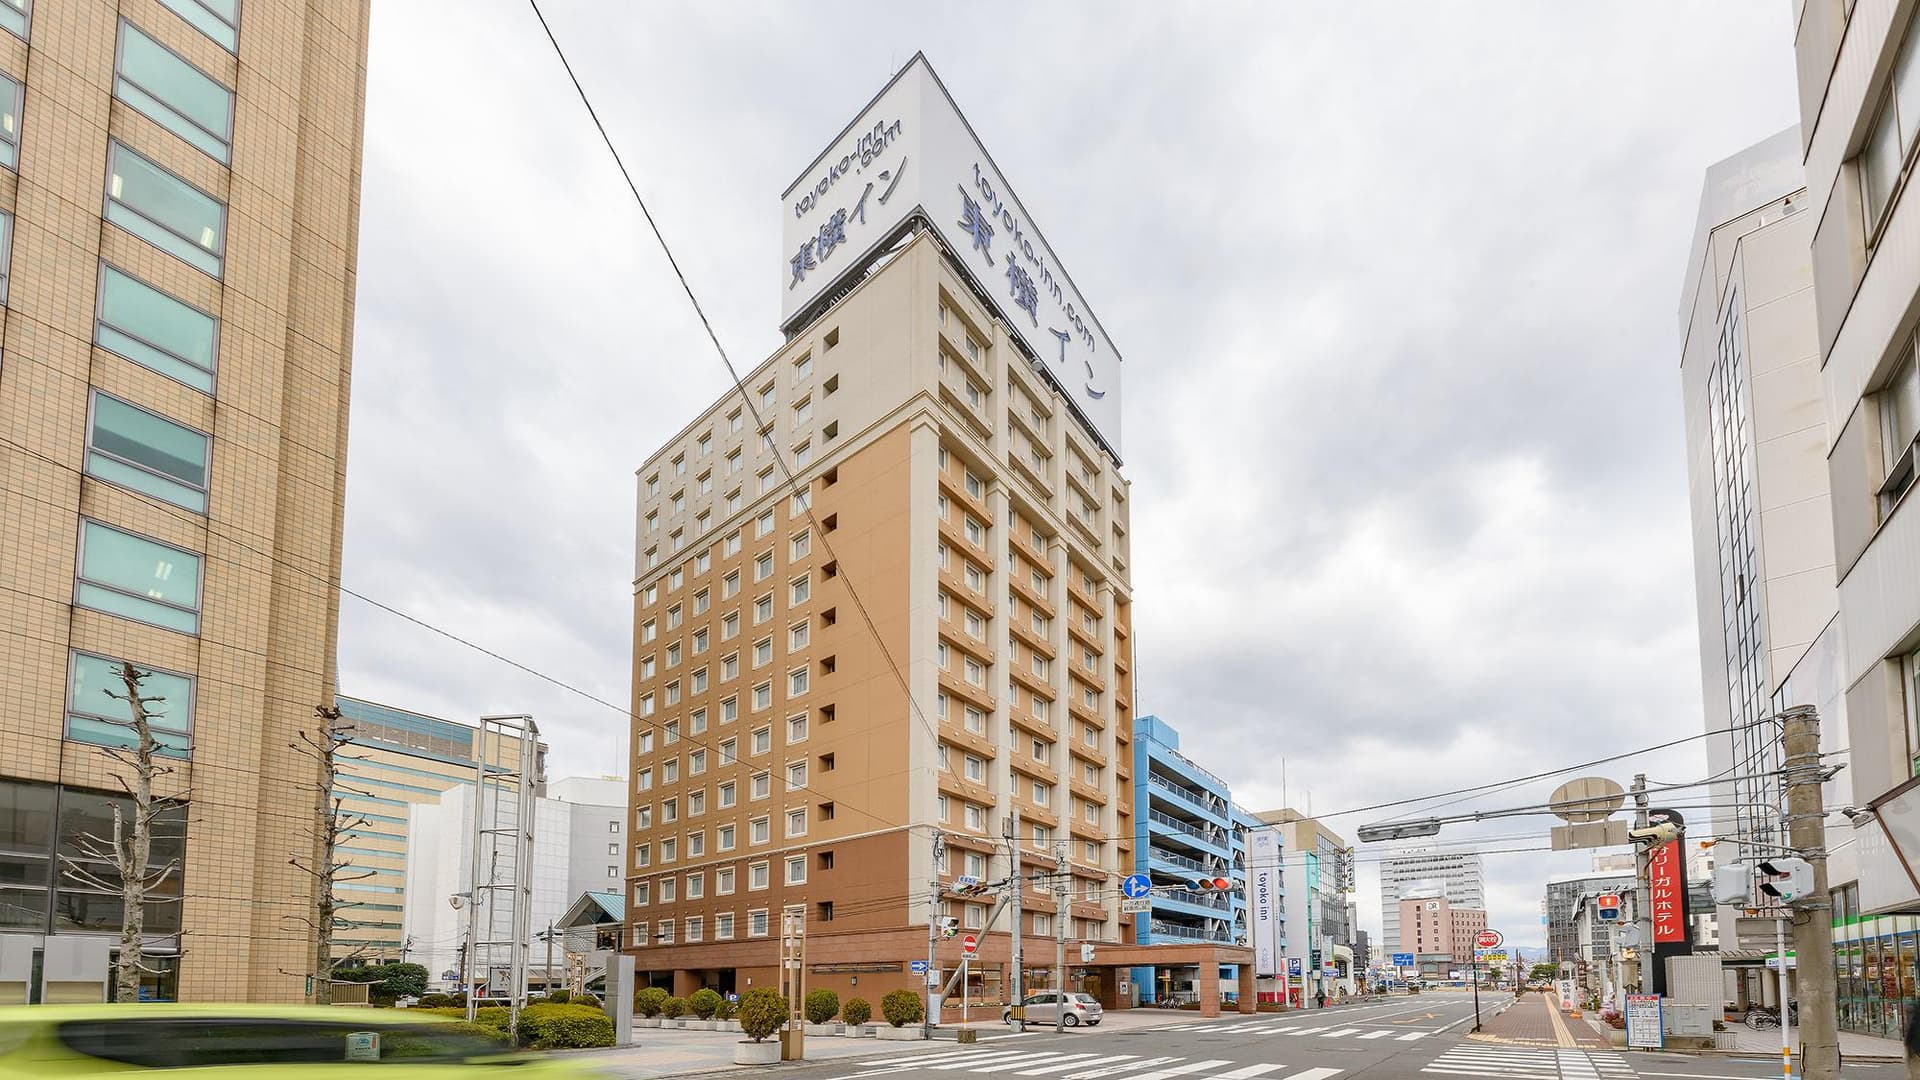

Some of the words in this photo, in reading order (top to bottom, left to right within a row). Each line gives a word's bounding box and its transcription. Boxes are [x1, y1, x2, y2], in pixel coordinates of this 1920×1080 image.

[973, 162, 1096, 353] toyoko-inn.com
[1258, 872, 1270, 905] toyoko
[1260, 905, 1268, 921] inn
